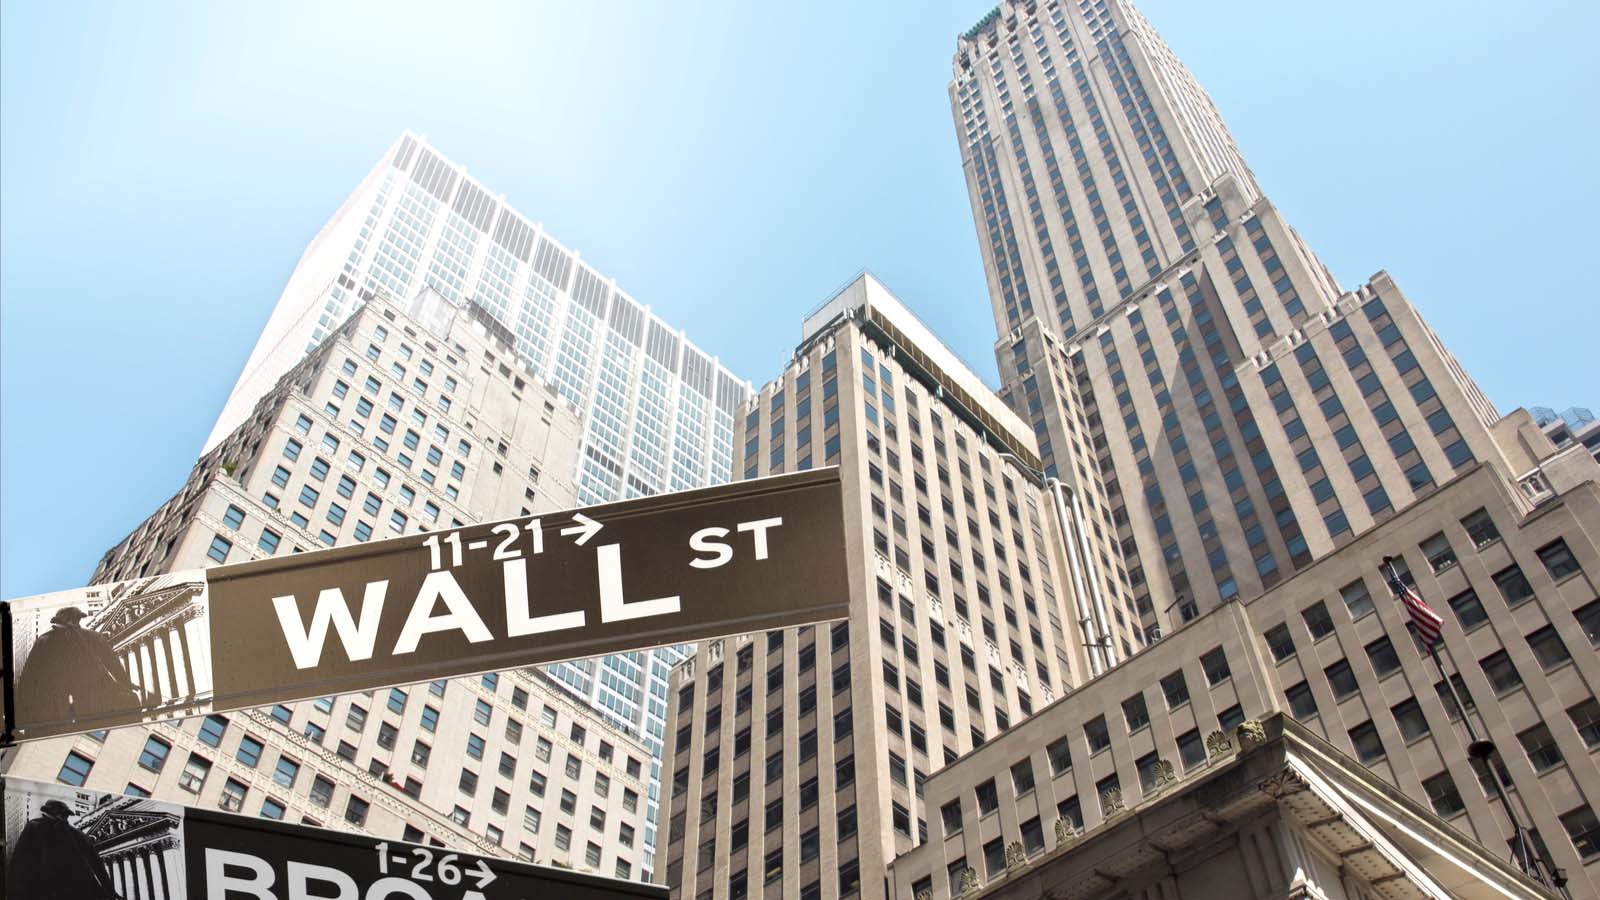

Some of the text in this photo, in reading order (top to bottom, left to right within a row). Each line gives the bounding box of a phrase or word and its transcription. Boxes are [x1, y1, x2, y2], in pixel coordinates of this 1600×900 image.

[422, 518, 544, 571] 11-21
[271, 516, 783, 670] WALL ST
[375, 841, 462, 886] 1-26
